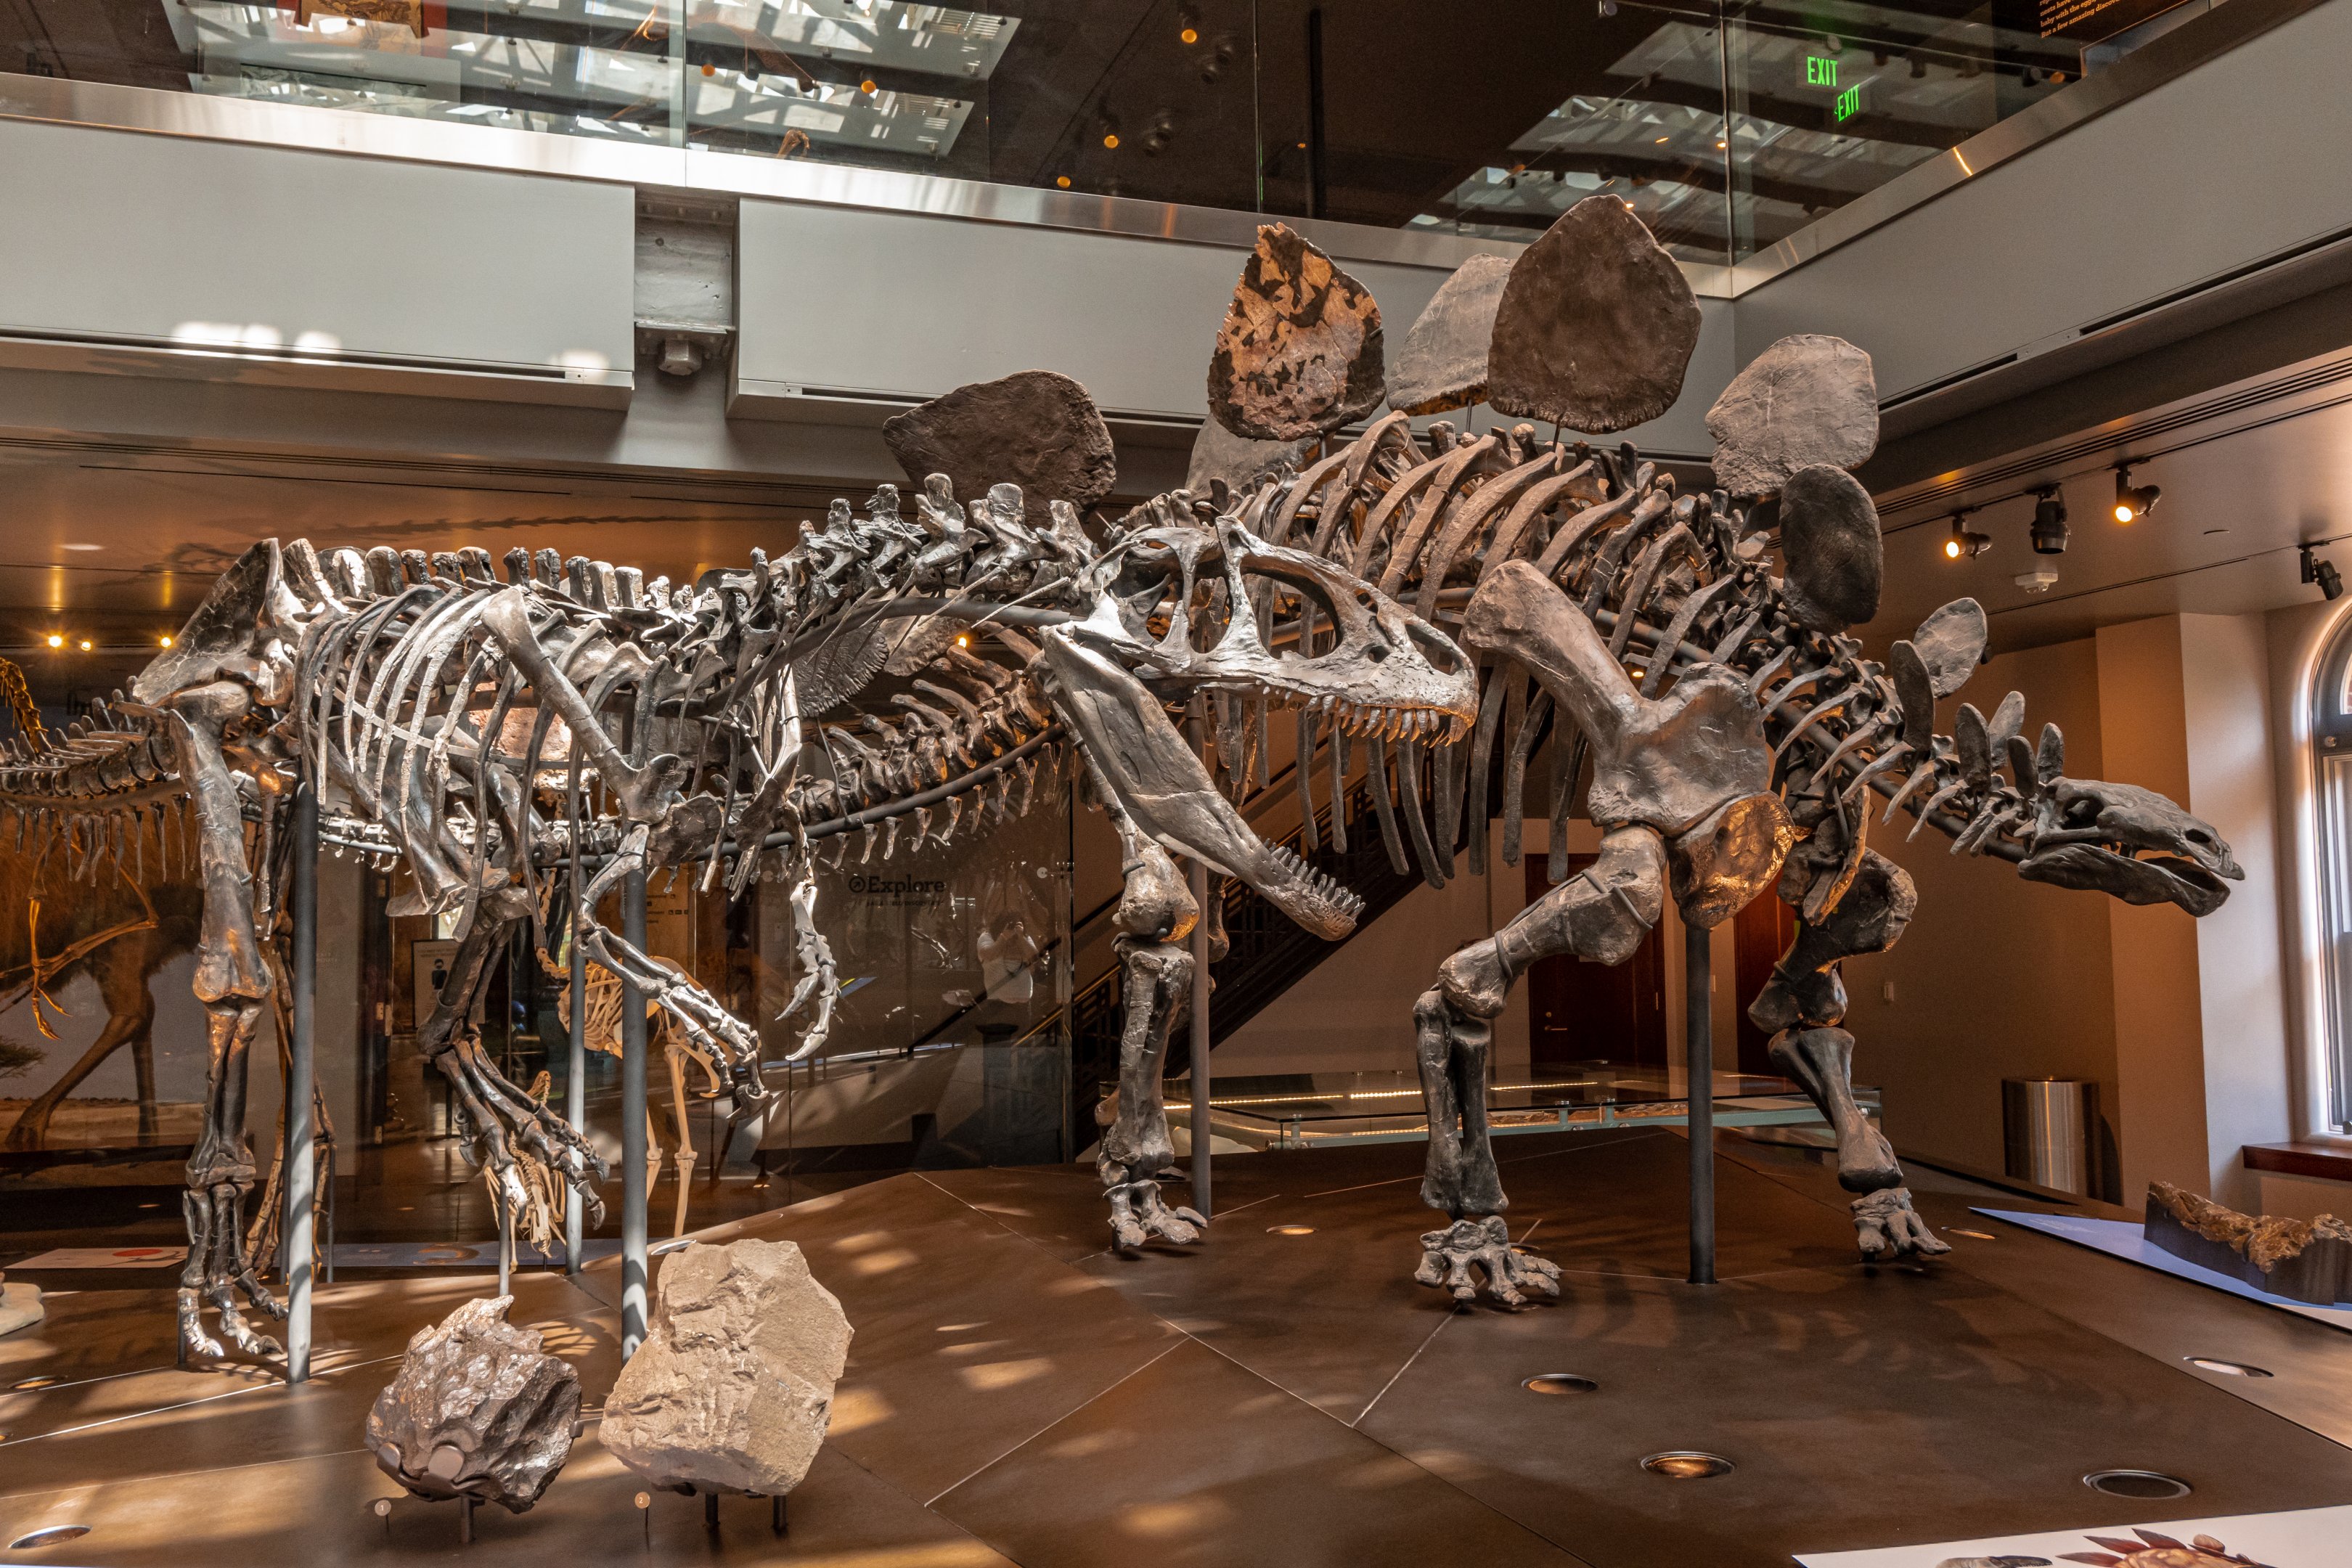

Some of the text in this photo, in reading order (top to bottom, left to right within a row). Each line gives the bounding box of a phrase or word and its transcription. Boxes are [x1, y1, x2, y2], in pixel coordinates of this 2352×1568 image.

[2041, 6, 2056, 17] nests
[2041, 17, 2055, 28] baby
[2056, 9, 2069, 20] with
[2041, 29, 2052, 38] But
[2057, 21, 2069, 30] few
[2069, 9, 2094, 25] amazing
[1807, 56, 1838, 87] EXIT
[1837, 83, 1860, 122] EXIT
[867, 874, 945, 897] Explore
